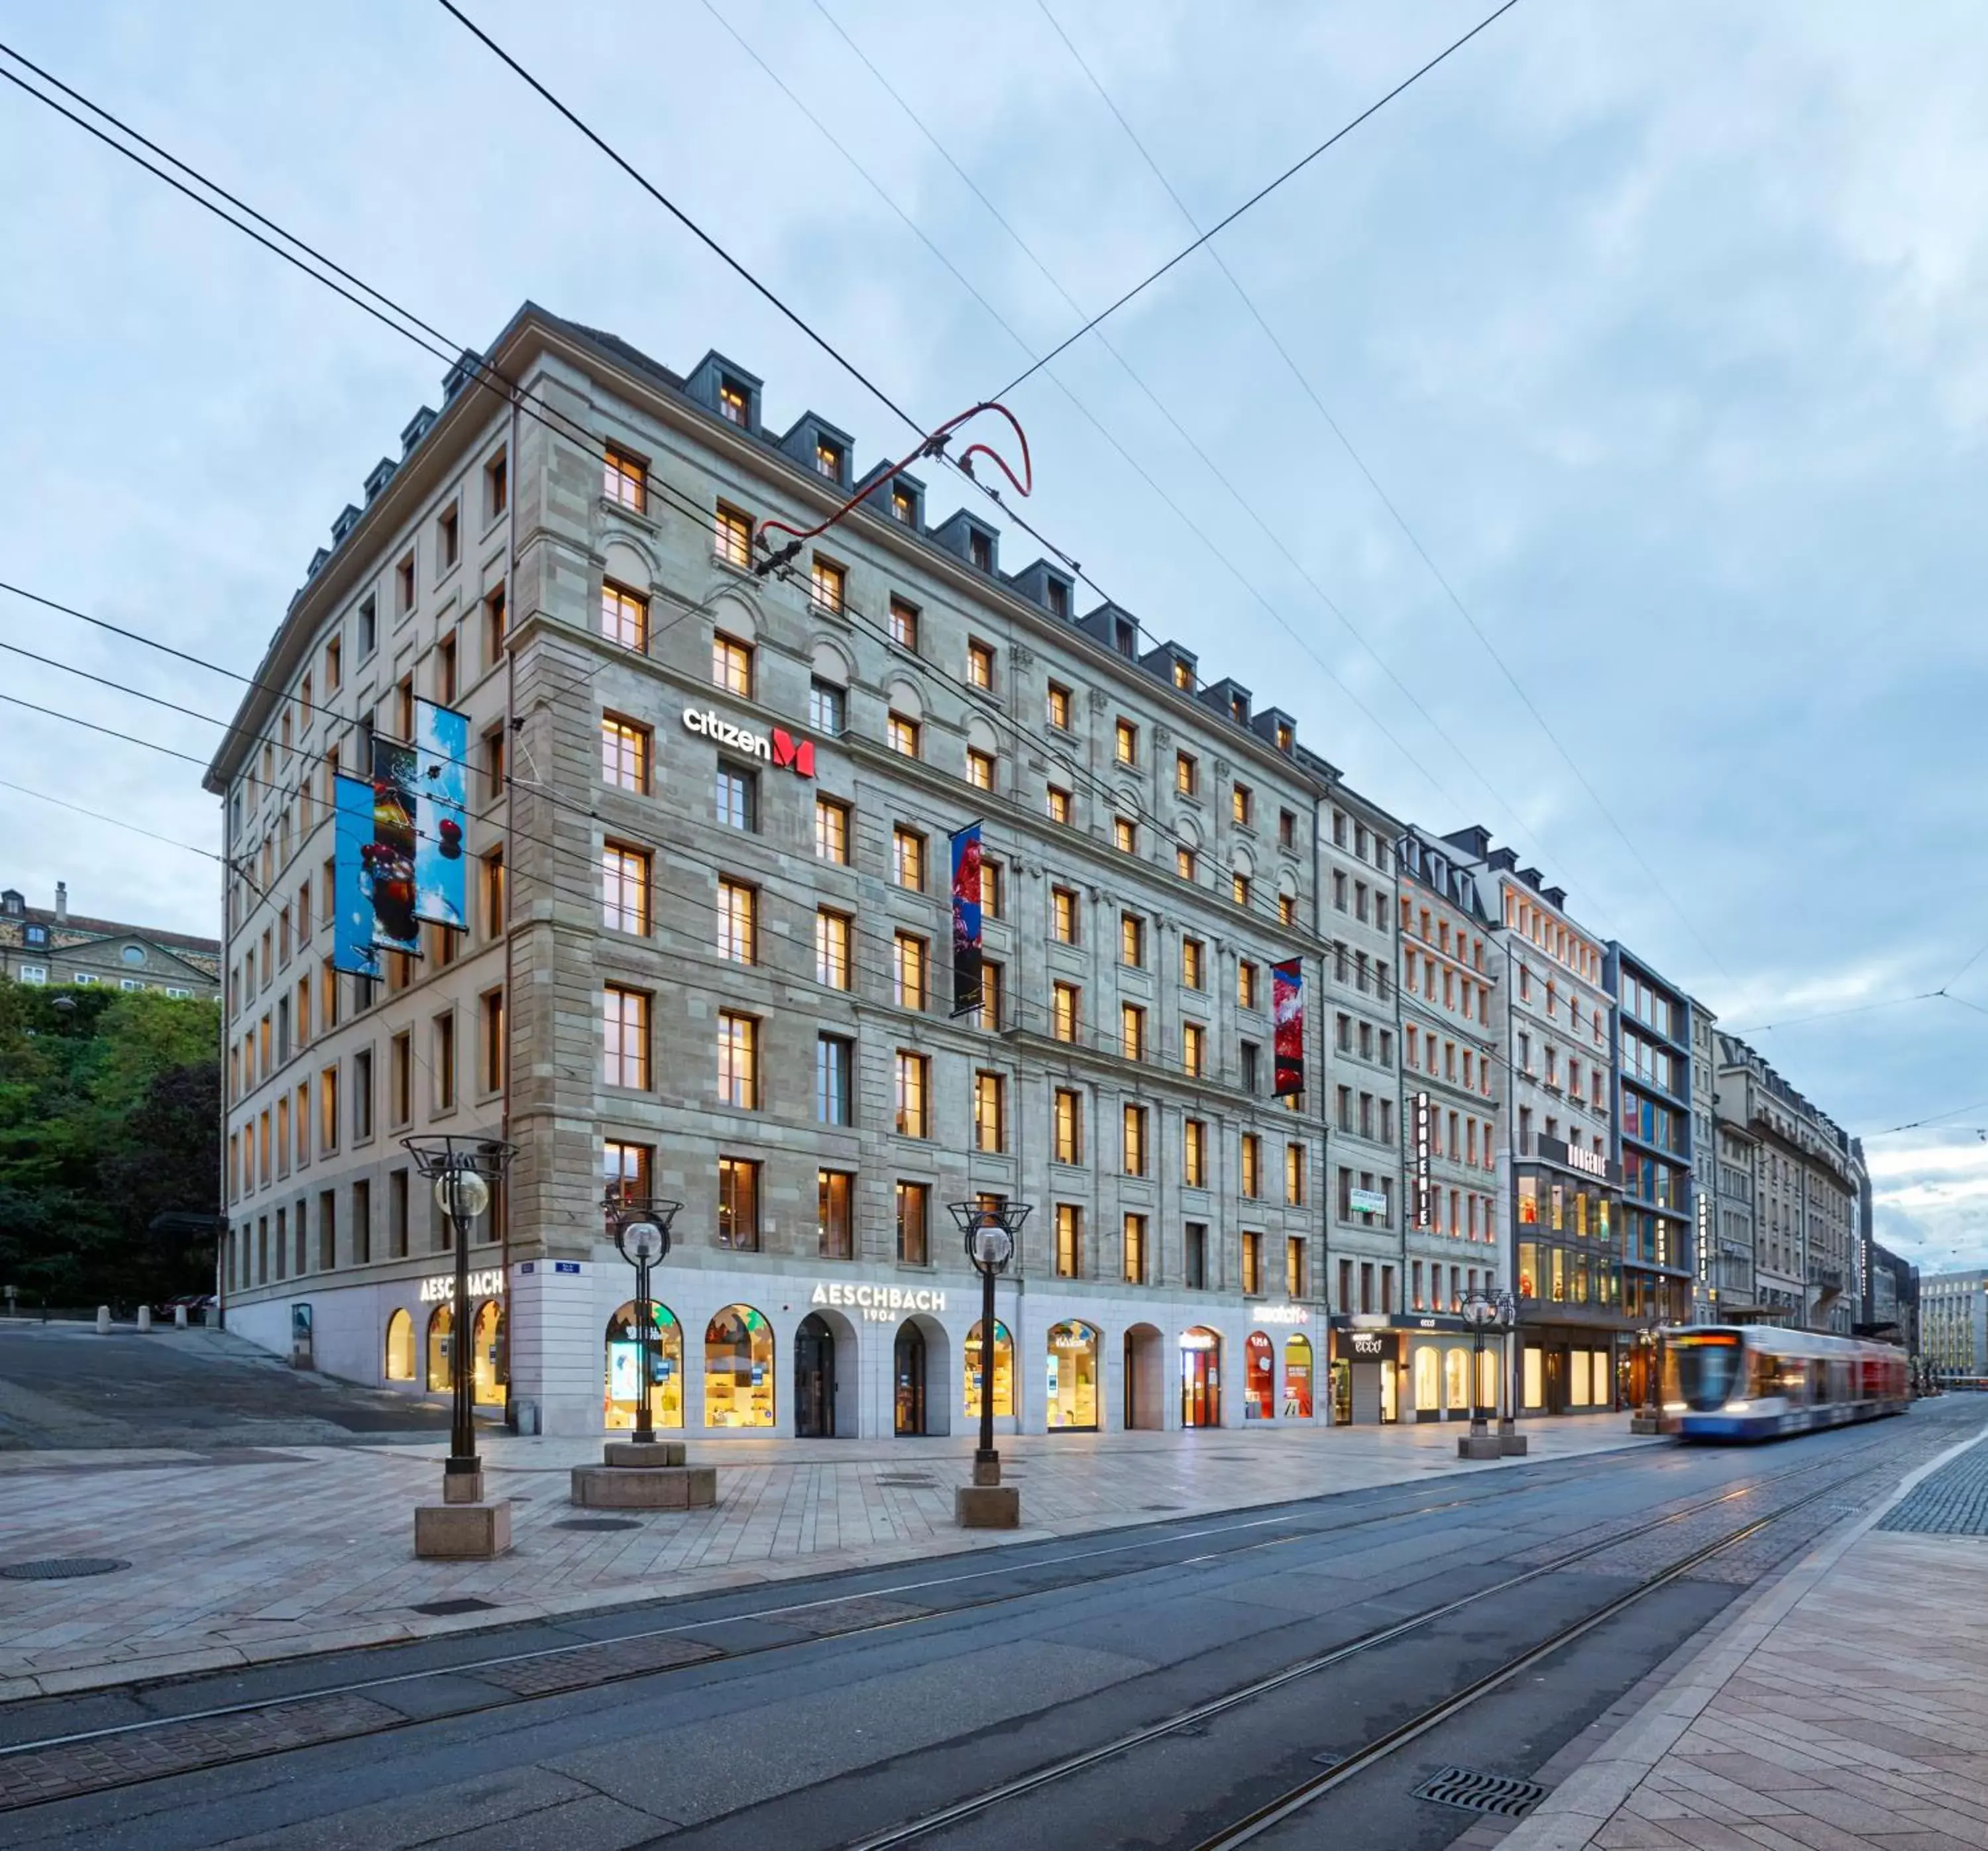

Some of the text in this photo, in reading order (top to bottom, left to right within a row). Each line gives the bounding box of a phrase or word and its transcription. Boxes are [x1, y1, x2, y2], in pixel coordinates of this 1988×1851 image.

[683, 708, 815, 778] citizenM
[419, 1270, 504, 1302] AESCACH
[812, 1281, 946, 1311] AESCHBACH
[863, 1309, 895, 1322] 1904
[1356, 1340, 1382, 1353] ecco
